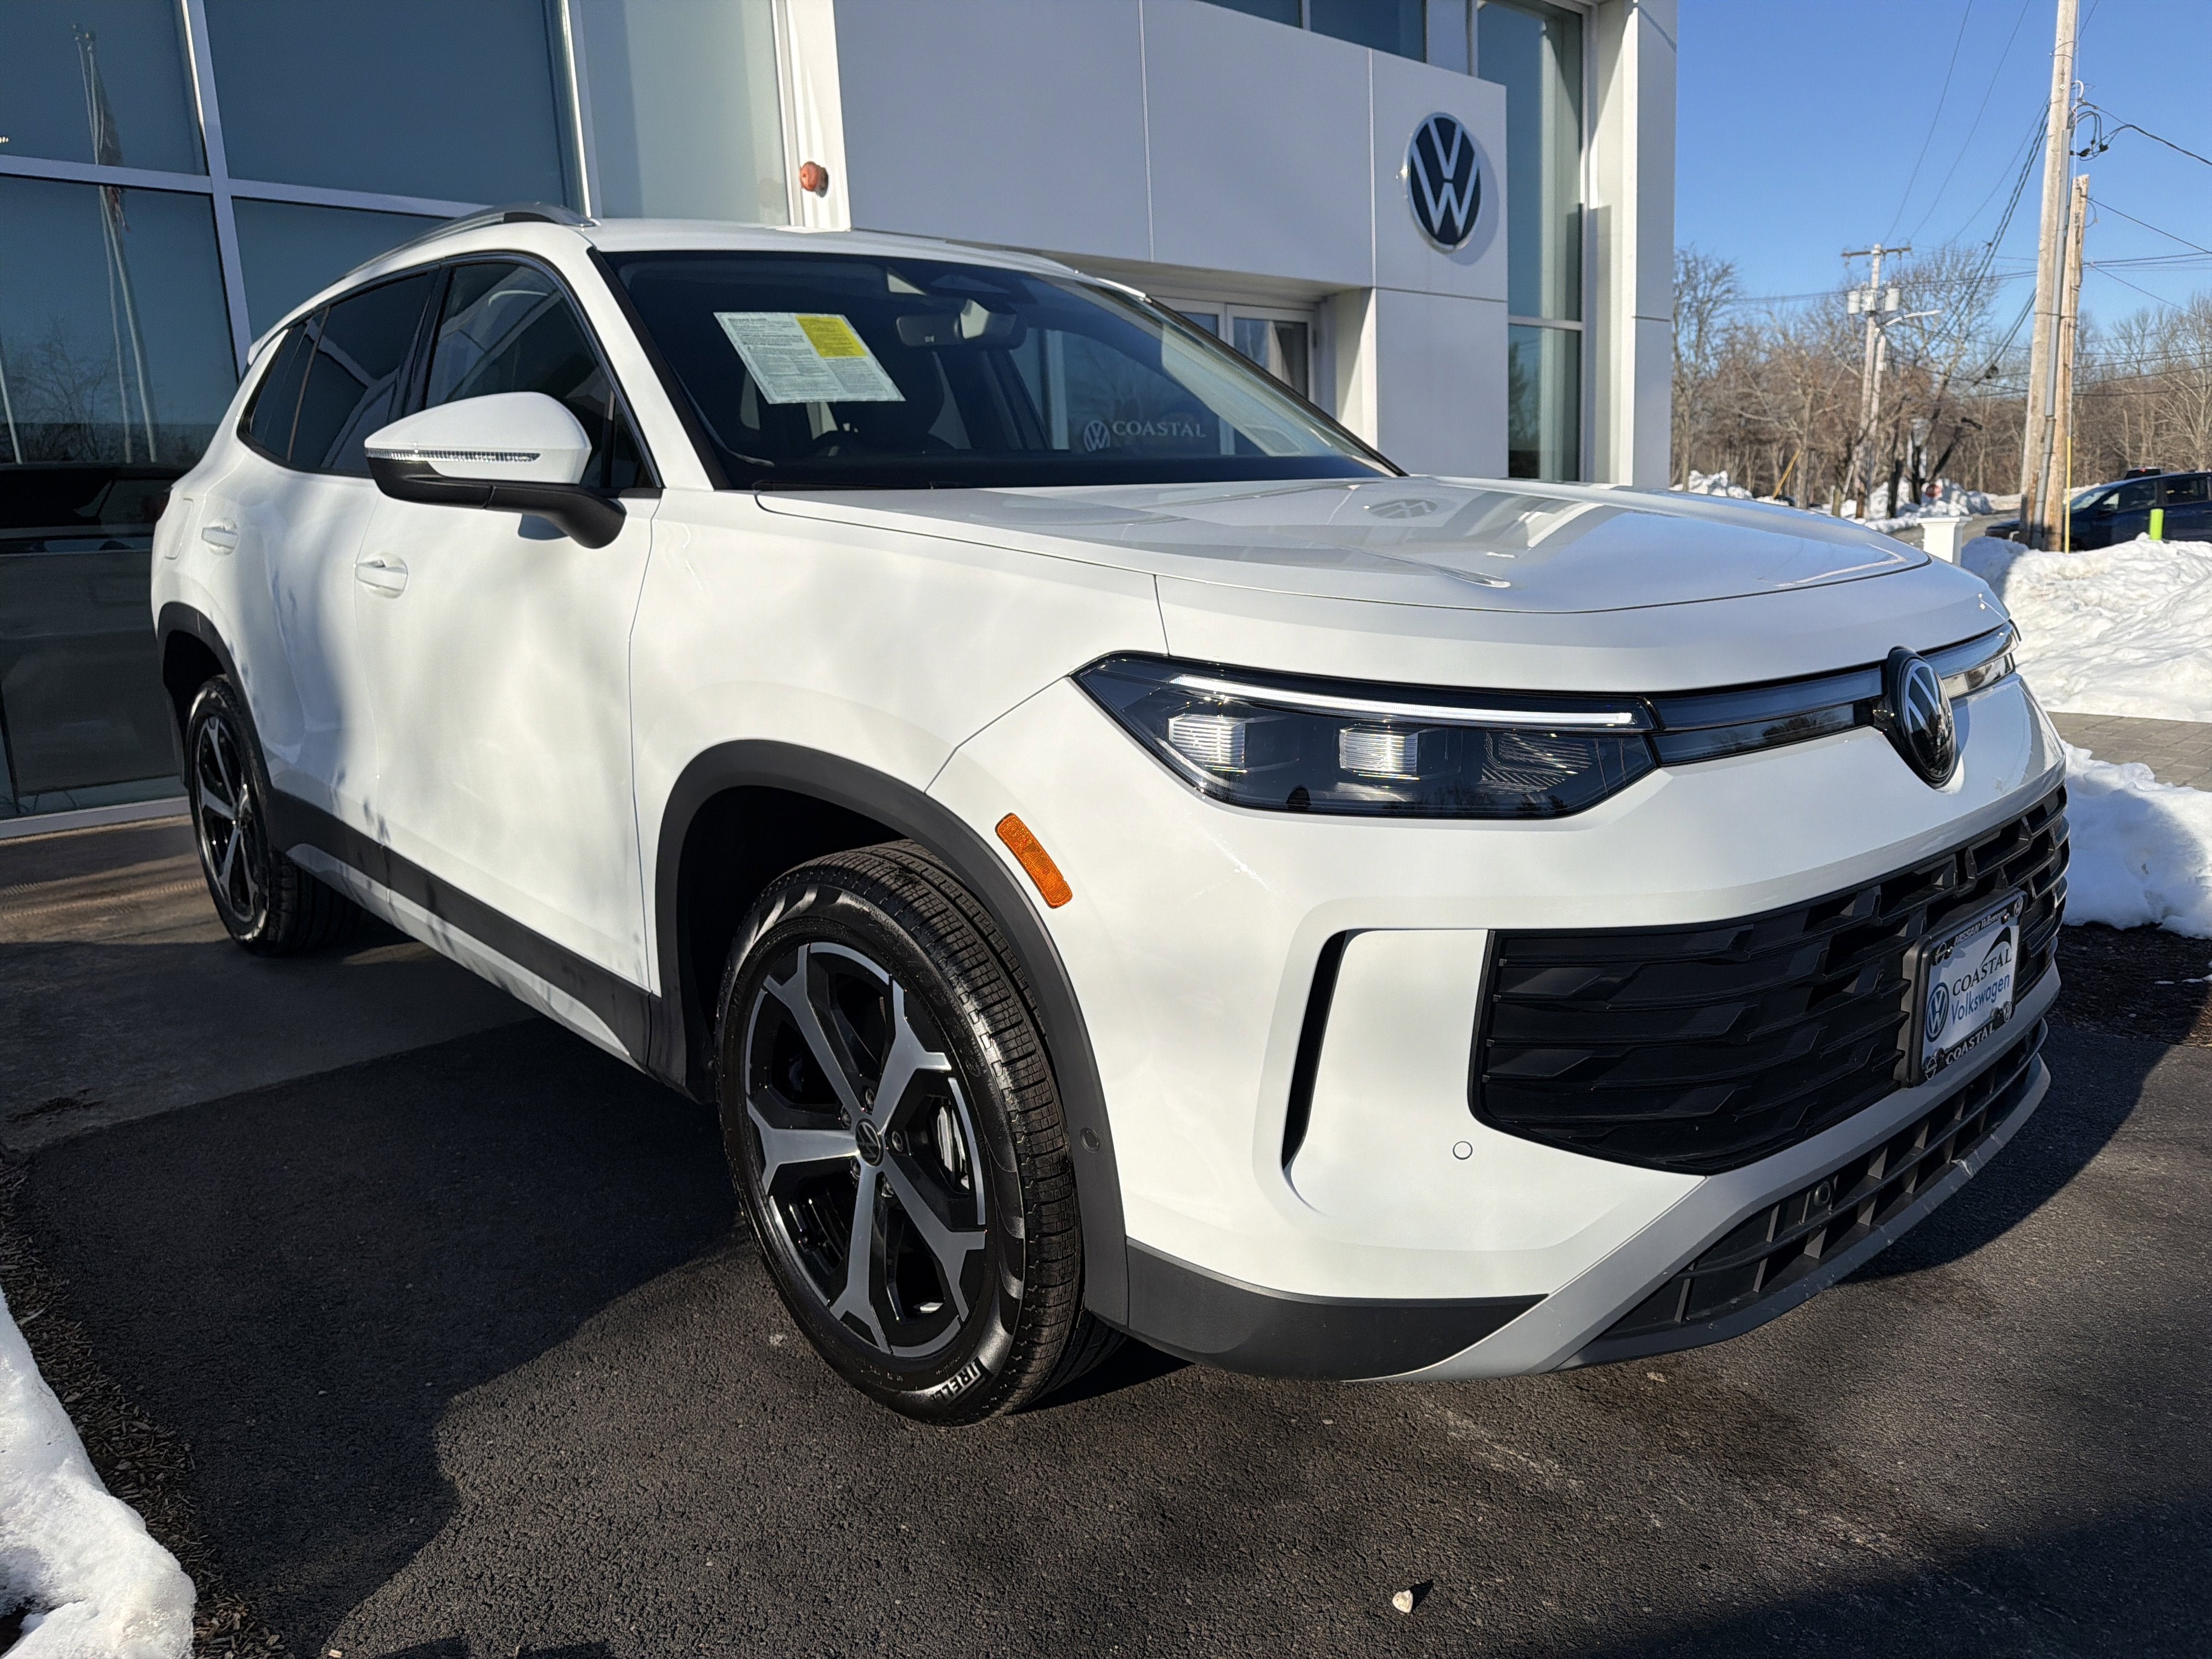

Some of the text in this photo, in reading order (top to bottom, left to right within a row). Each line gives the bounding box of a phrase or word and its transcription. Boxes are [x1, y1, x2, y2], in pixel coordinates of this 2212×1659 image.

[1408, 113, 1482, 250] VW
[1112, 421, 1206, 438] COASTAL
[1952, 947, 2012, 996] COASTAL
[1951, 974, 2010, 1025] Volkswagen
[1946, 1023, 1995, 1064] COASTAL
